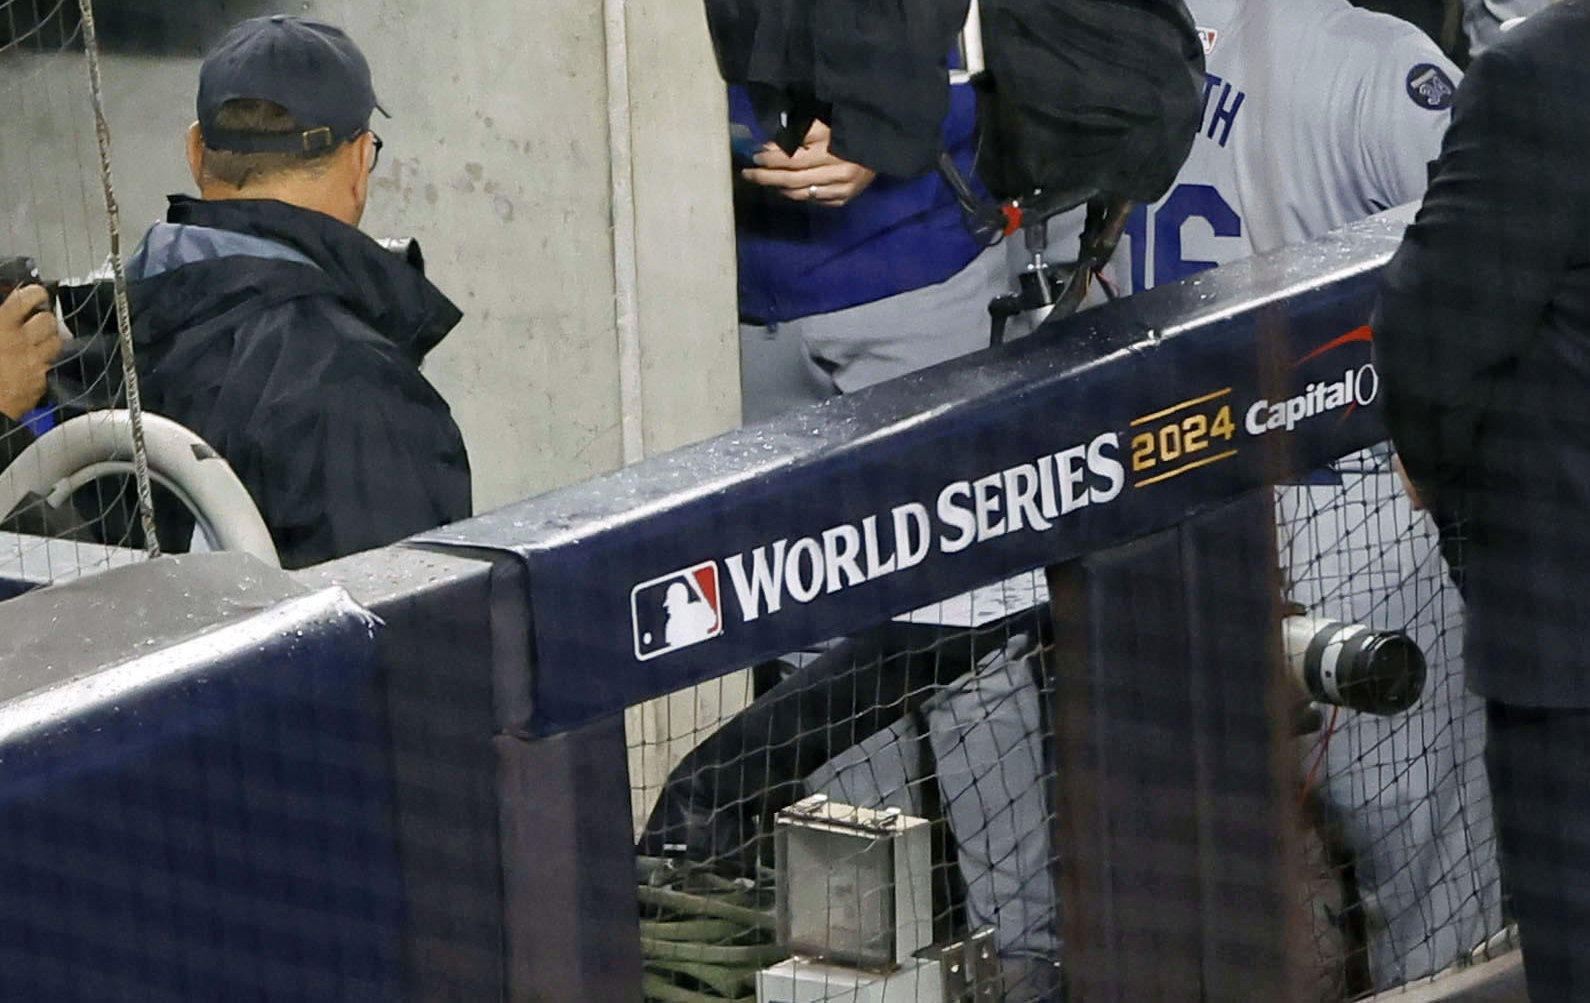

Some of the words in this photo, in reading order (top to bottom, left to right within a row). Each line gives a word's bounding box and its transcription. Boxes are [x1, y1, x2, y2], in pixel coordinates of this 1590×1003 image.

[724, 501, 932, 623] WORLD
[937, 432, 1126, 554] SERIES
[1131, 405, 1237, 472] 2024
